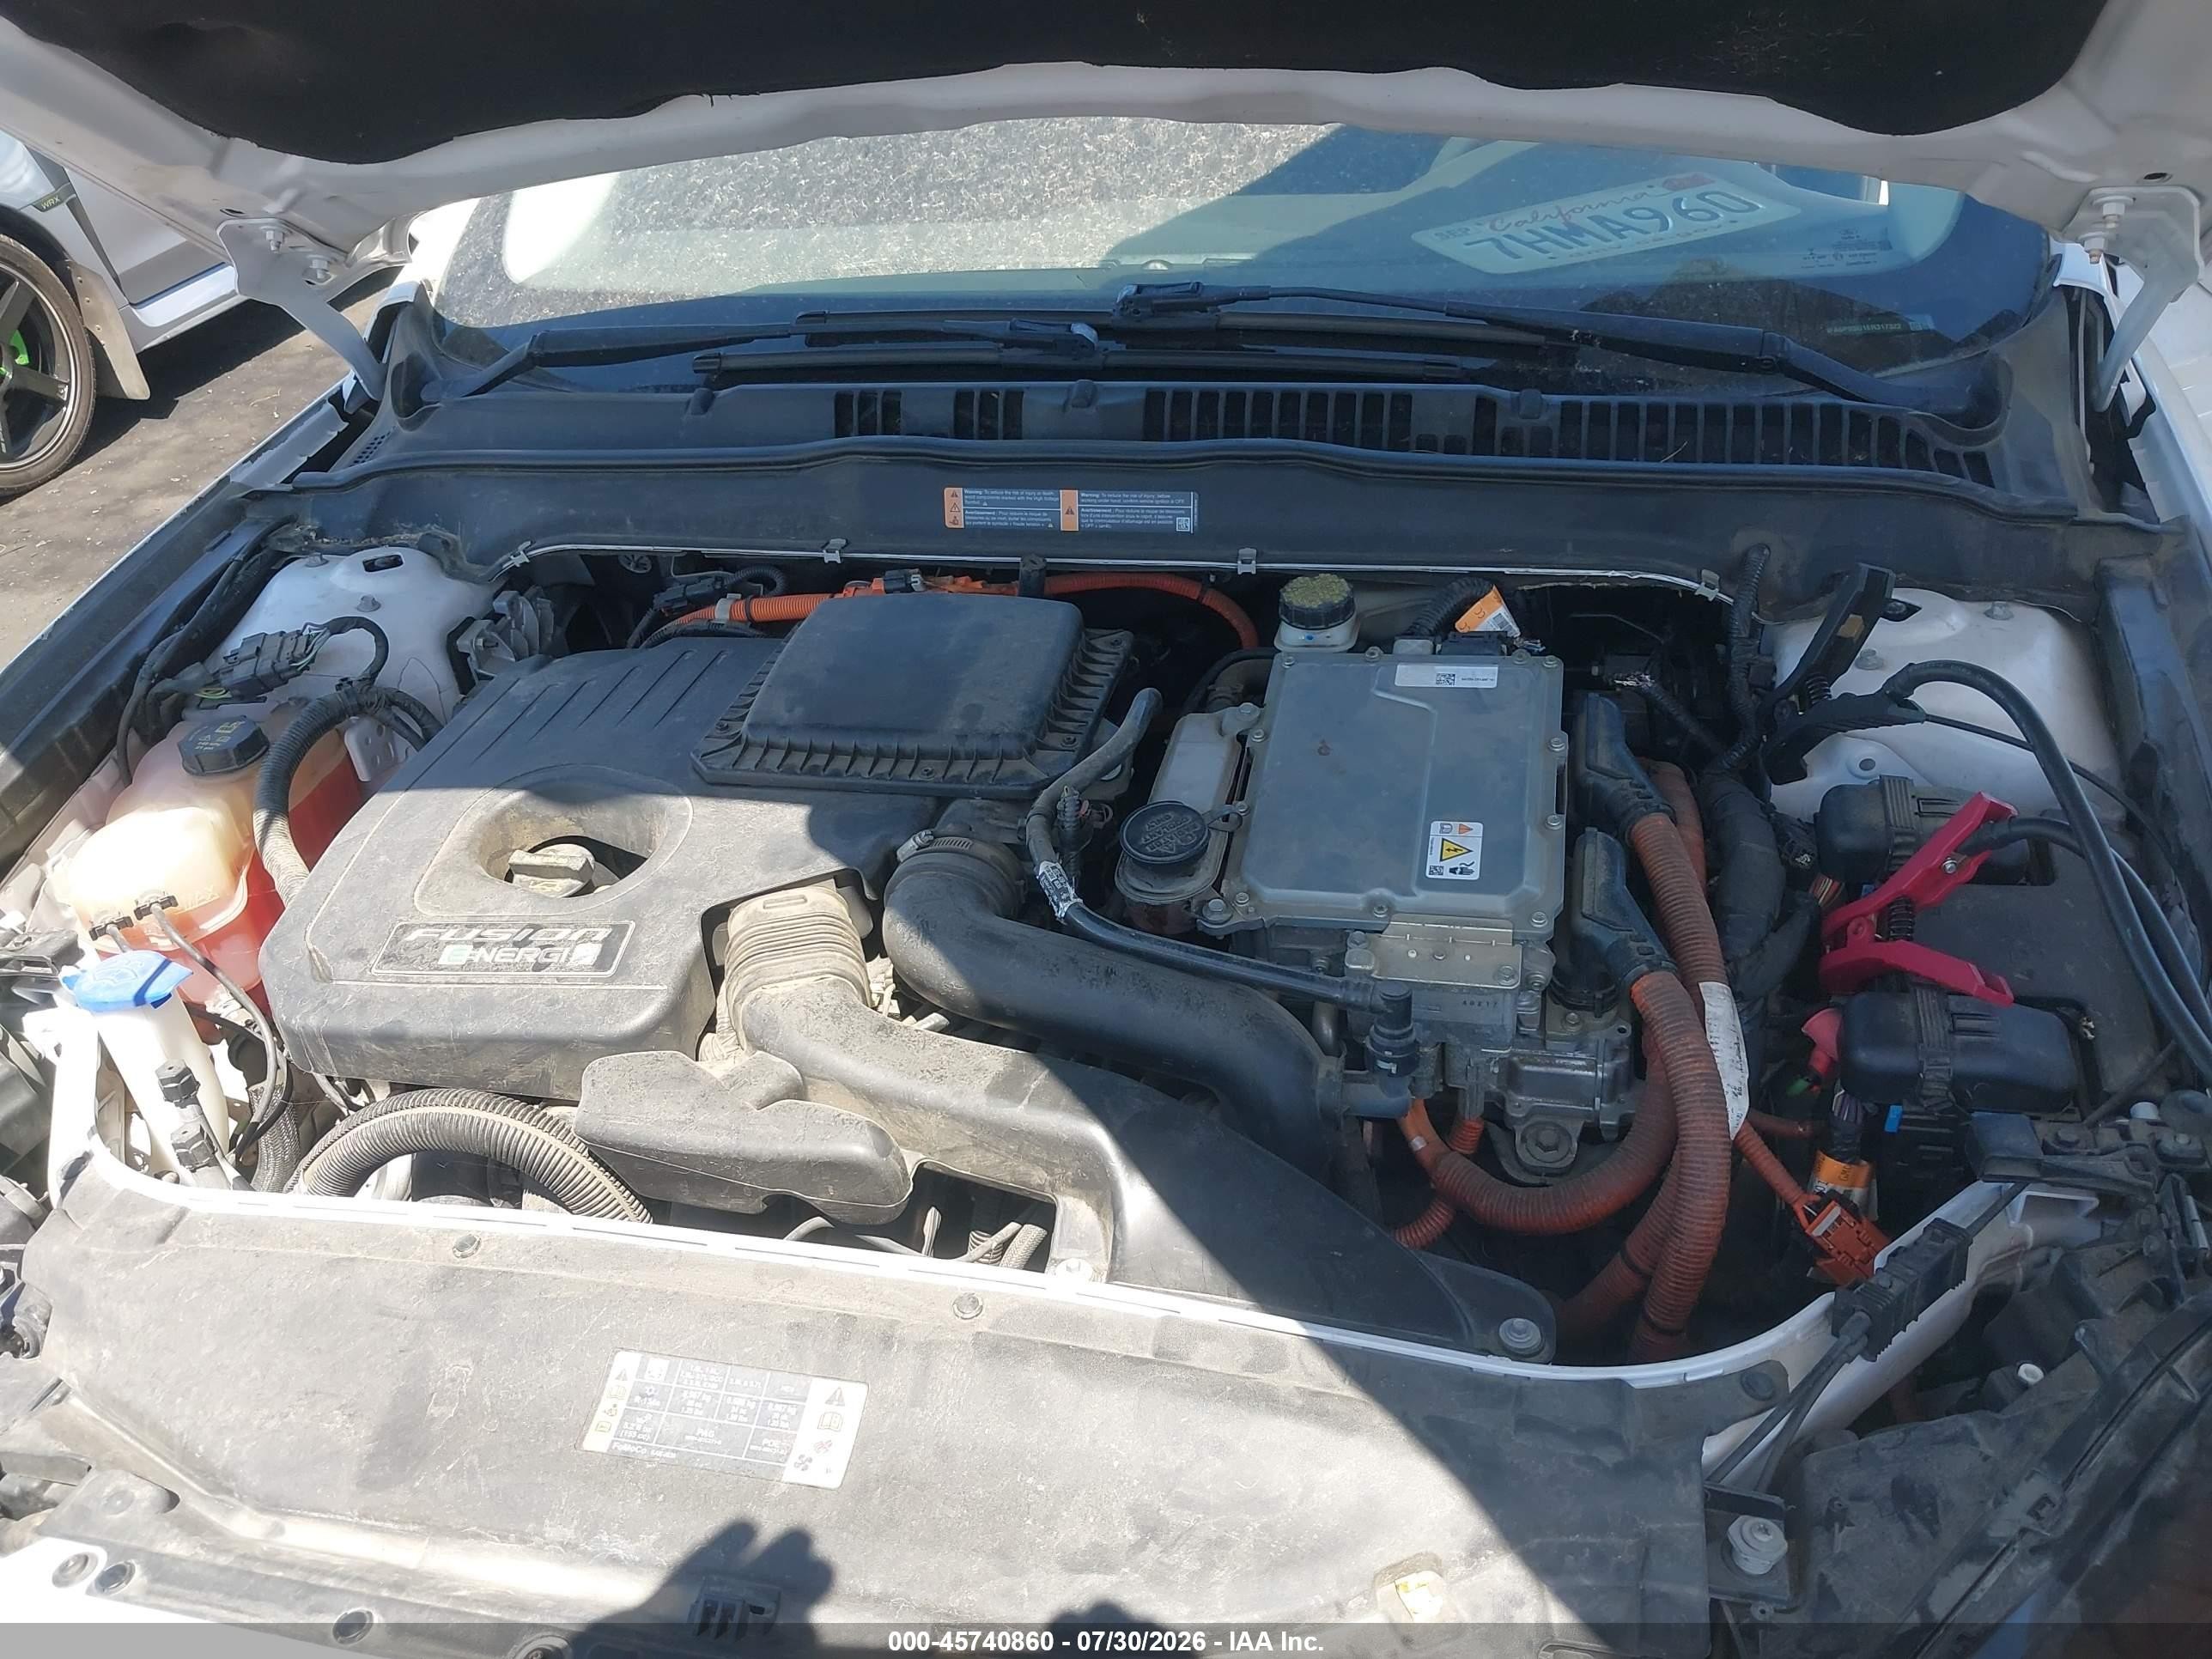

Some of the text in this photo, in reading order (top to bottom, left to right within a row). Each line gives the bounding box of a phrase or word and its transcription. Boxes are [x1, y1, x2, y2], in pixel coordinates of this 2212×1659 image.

[40, 195, 60, 210] WRX
[1486, 191, 1672, 232] California
[1463, 190, 1762, 259] 7HMA960
[1141, 817, 1192, 844] COOLANT
[1146, 812, 1173, 831] ONLY
[403, 927, 613, 942] FUSION
[437, 944, 568, 965] ENERGI
[696, 1428, 716, 1439] PAG
[611, 1441, 647, 1455] FoMoCo
